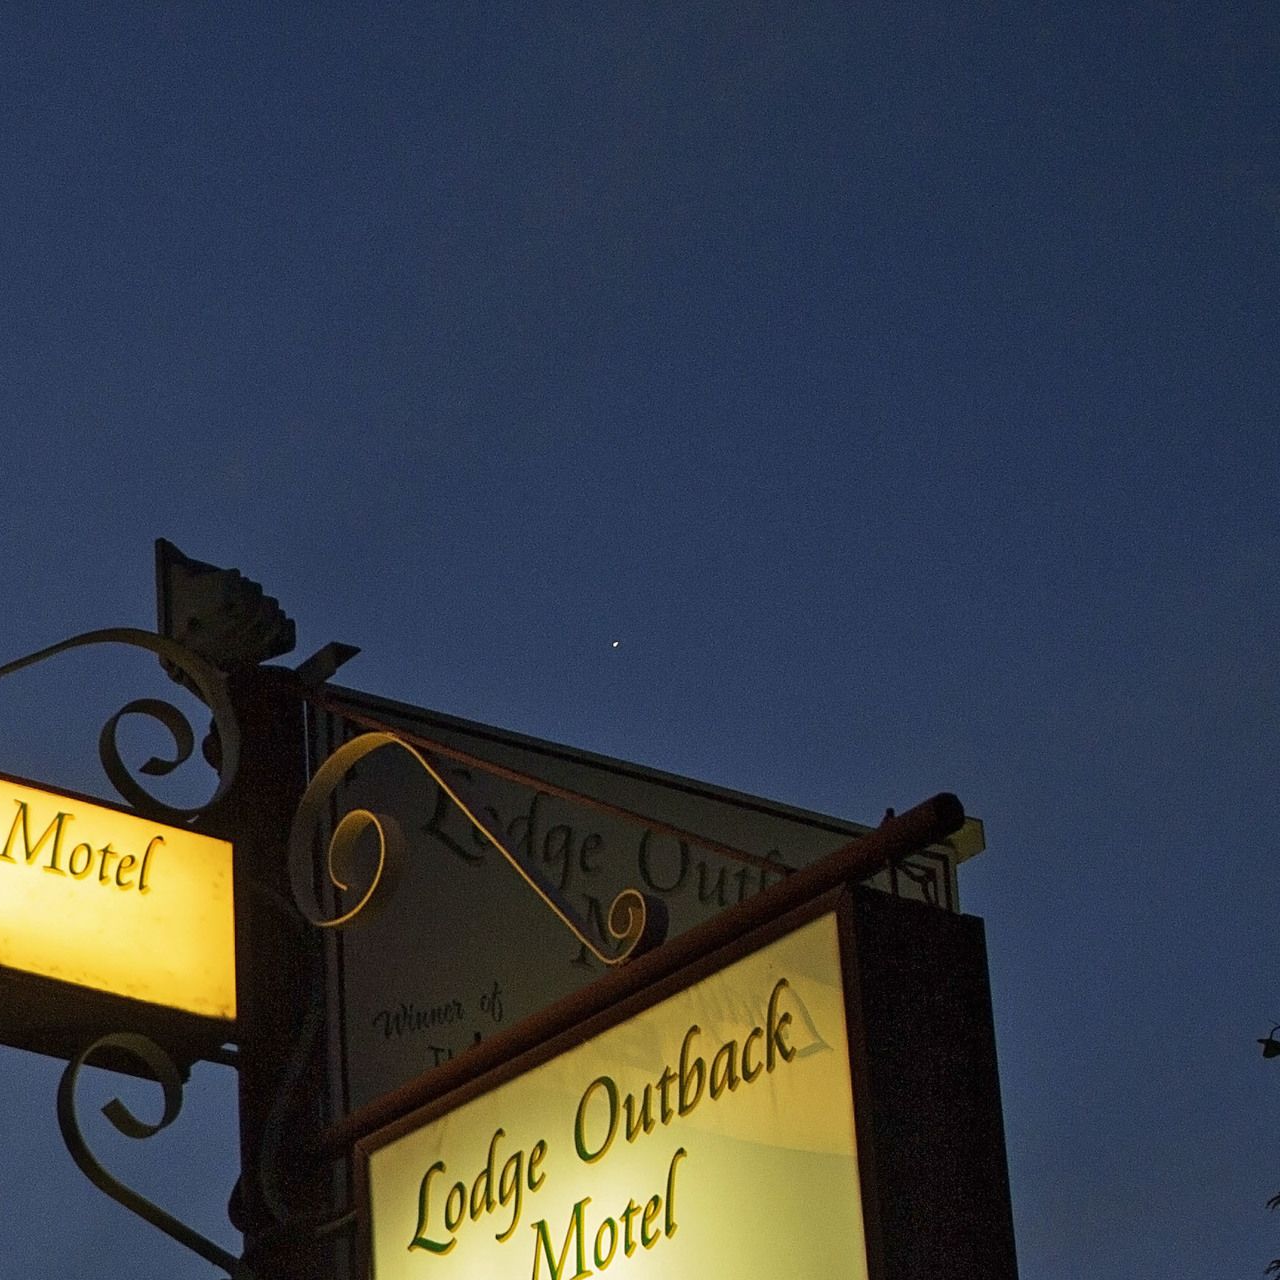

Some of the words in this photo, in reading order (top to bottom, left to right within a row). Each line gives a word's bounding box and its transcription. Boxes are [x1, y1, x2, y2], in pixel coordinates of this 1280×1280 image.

[372, 1000, 465, 1038] Winner
[479, 980, 504, 1023] of
[407, 1128, 548, 1256] Lodge
[574, 977, 797, 1165] Outback
